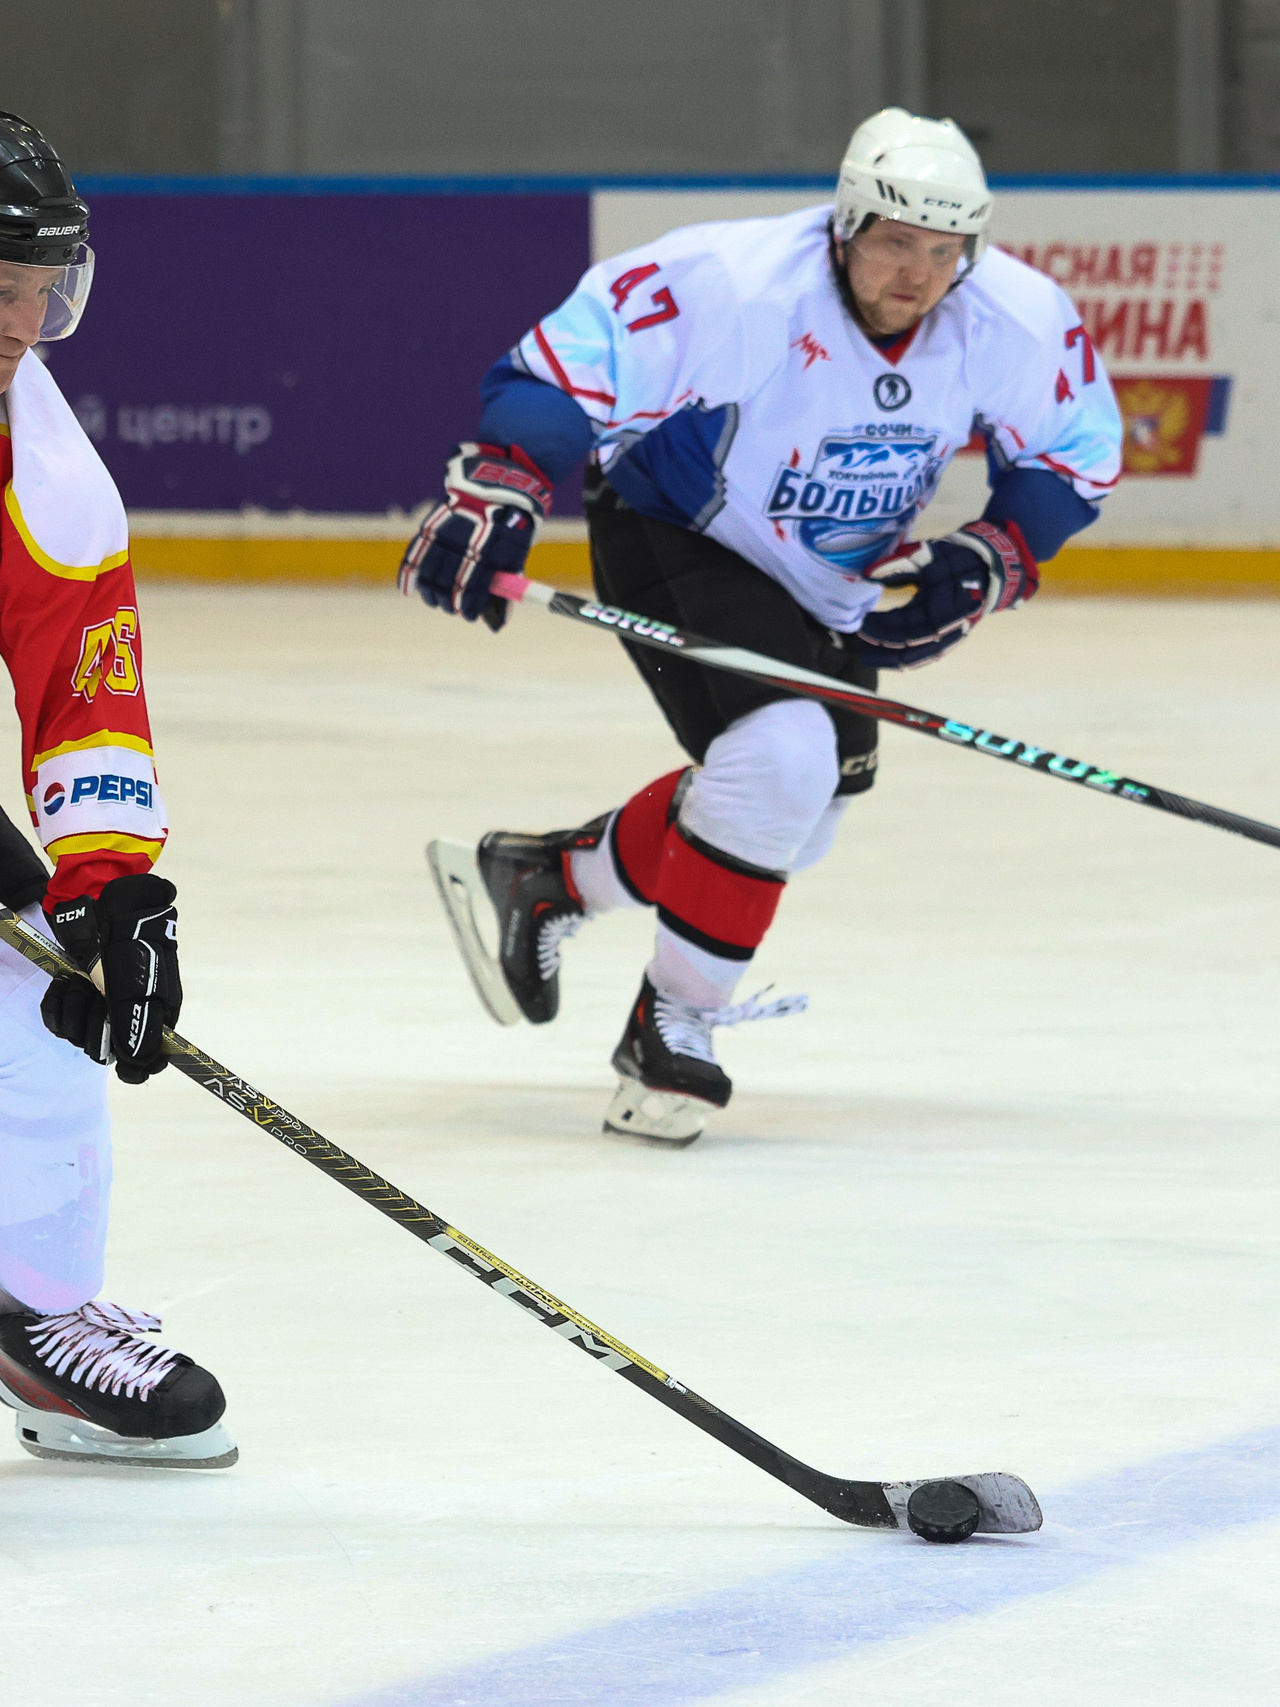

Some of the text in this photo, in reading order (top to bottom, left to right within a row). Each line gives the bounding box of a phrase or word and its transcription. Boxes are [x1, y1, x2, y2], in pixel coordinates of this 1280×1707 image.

[922, 196, 962, 209] CCM
[37, 225, 80, 247] BAUER
[996, 242, 1159, 287] СНАЯ
[610, 262, 680, 334] 47
[117, 405, 272, 455] центр
[767, 467, 932, 518] БОЛЬШ
[70, 774, 153, 809] PEPSI
[55, 906, 87, 924] CCM
[128, 1003, 143, 1049] CCM
[227, 1075, 277, 1111] AS-V
[202, 1076, 308, 1157] AS-V PRO
[426, 1233, 634, 1371] CCM
